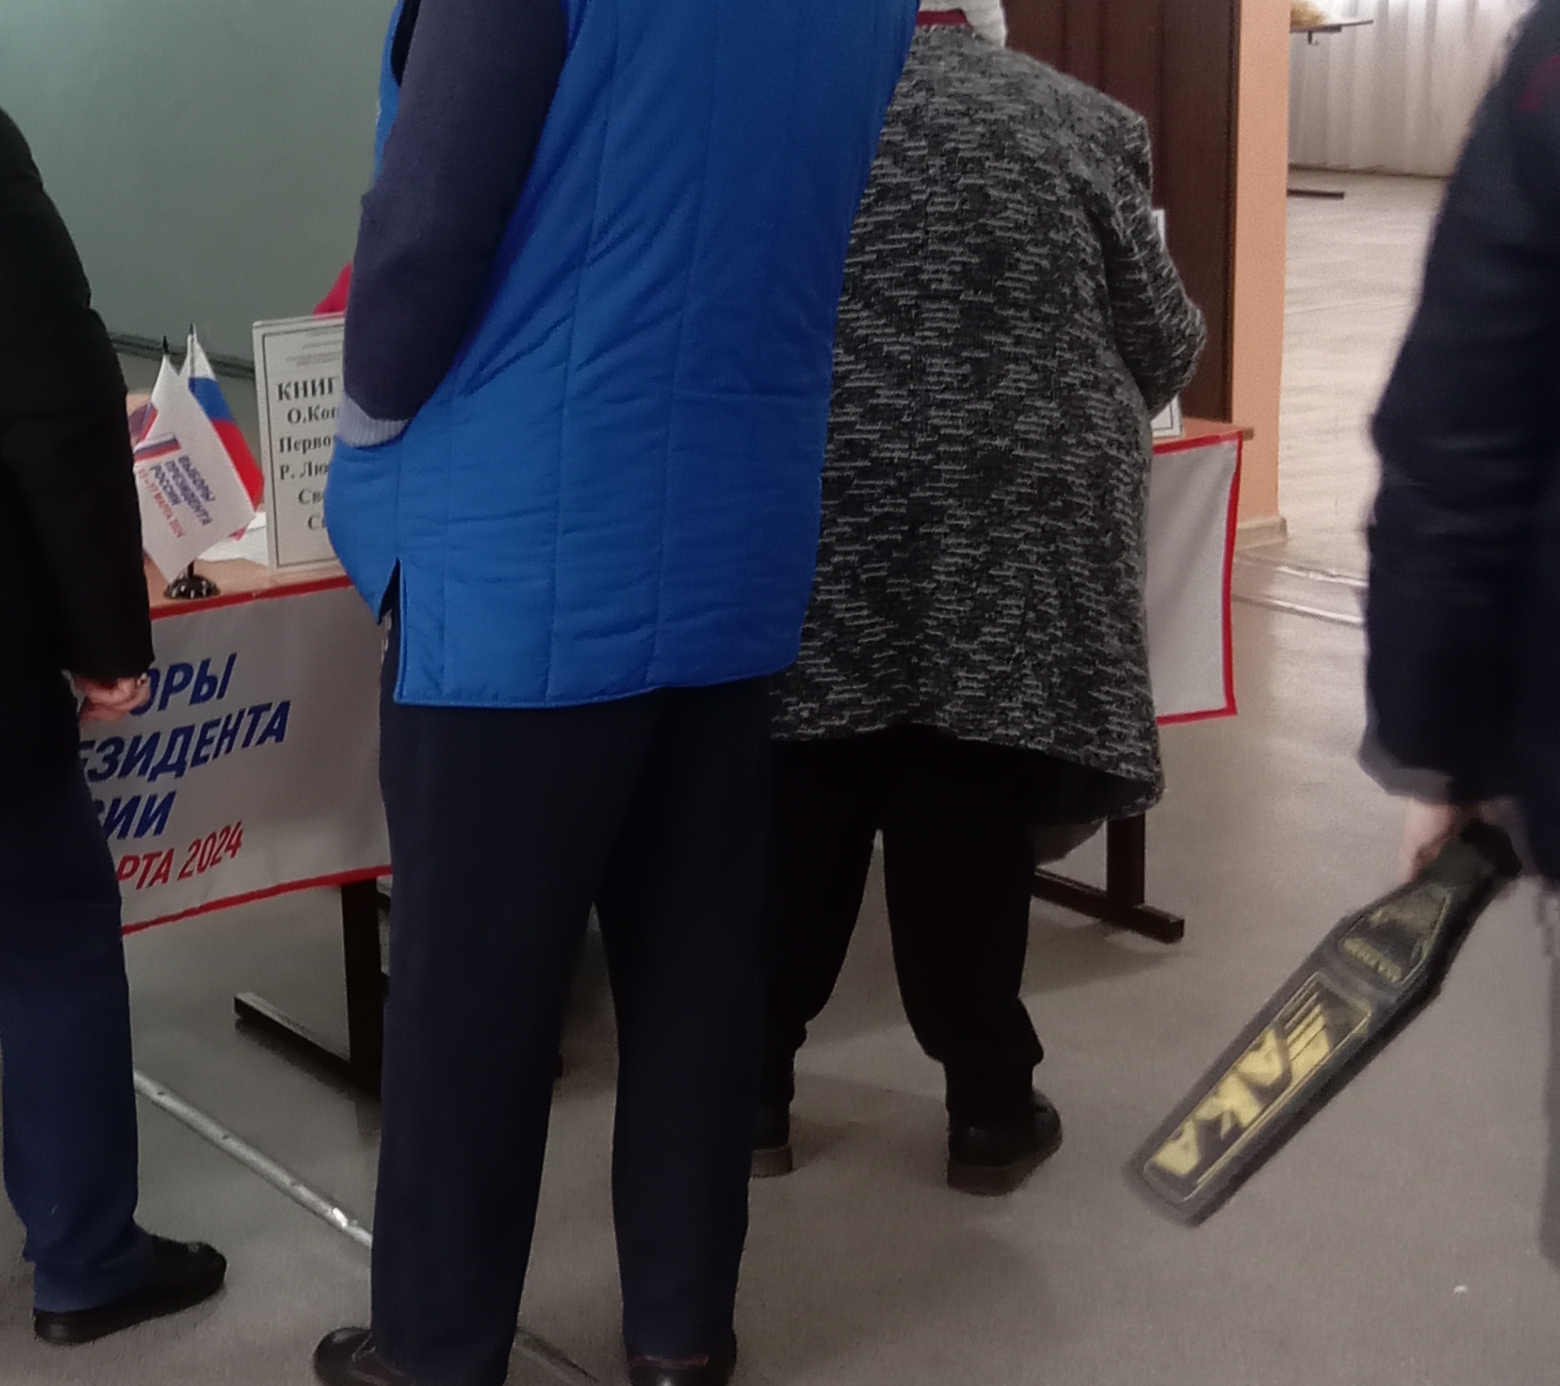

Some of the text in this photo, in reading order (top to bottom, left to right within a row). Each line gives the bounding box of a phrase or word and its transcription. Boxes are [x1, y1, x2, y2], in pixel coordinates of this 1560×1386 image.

[277, 375, 339, 401] КНИГ
[300, 462, 327, 478] Лю
[130, 653, 237, 716] ОРЫ
[80, 700, 290, 783] ЗИДЕНТА
[117, 820, 243, 890] РТА 2024
